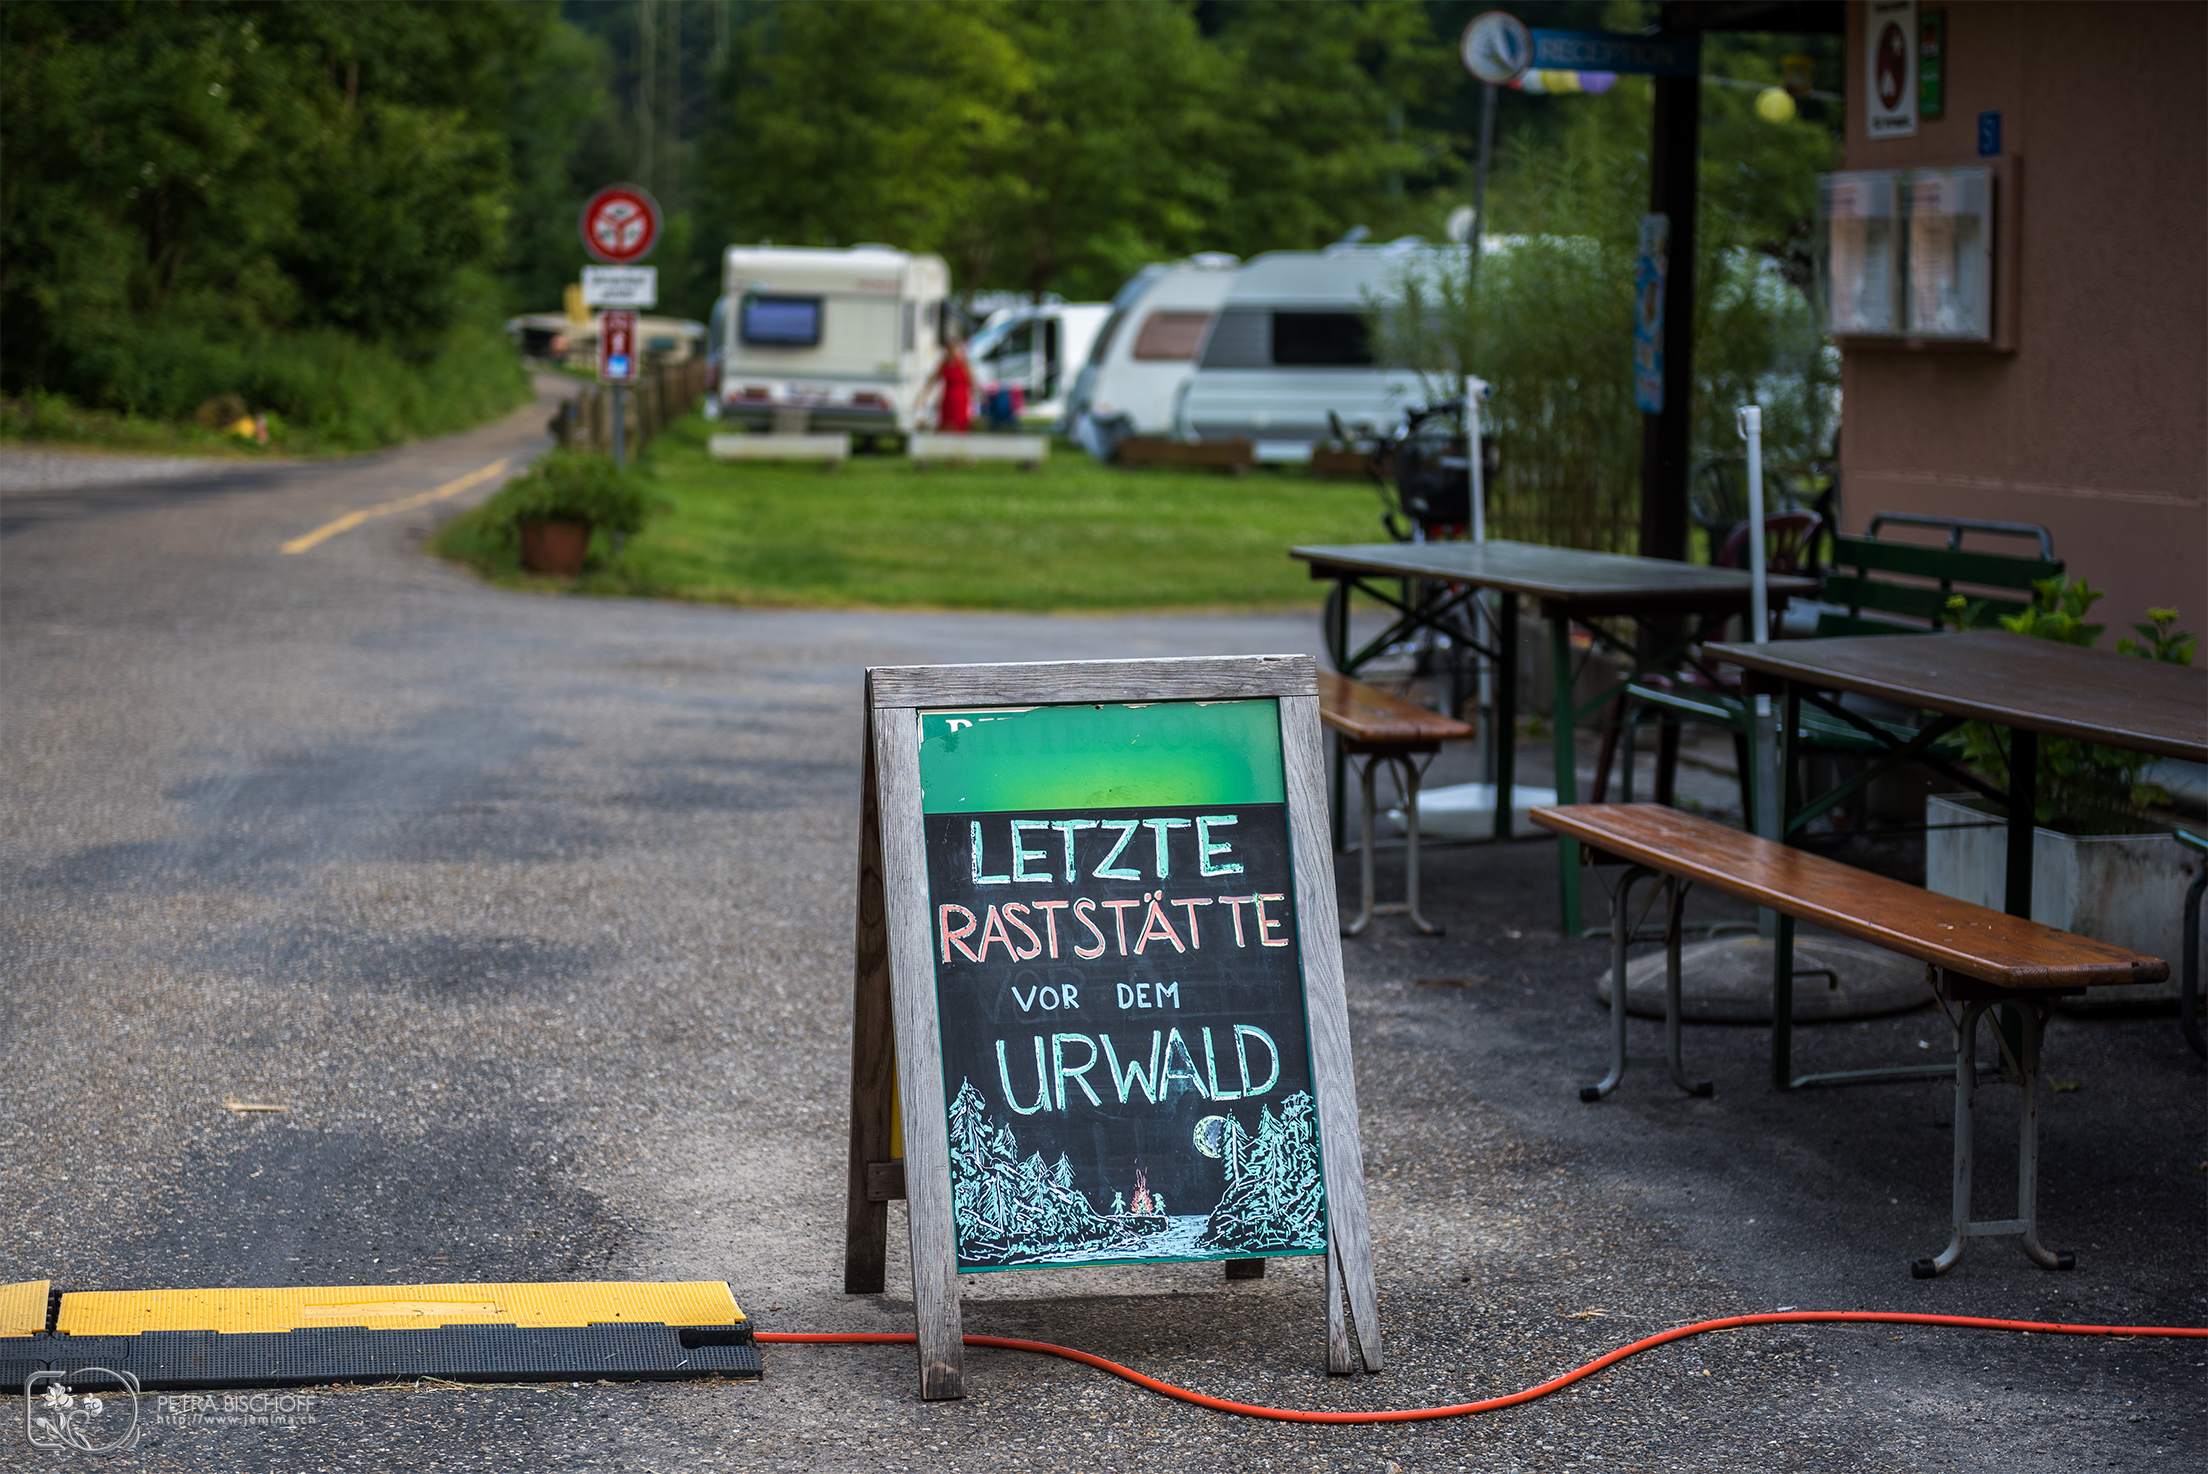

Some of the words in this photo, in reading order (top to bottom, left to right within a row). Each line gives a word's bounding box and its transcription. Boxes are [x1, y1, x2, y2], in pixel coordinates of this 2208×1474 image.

[1537, 37, 1677, 66] RECEPTION
[970, 815, 1243, 884] LETZTE
[939, 891, 1289, 964] RASTSTÄTTE
[1011, 984, 1080, 1012] VOR
[1117, 981, 1181, 1009] DEM
[995, 1024, 1280, 1114] URWALD
